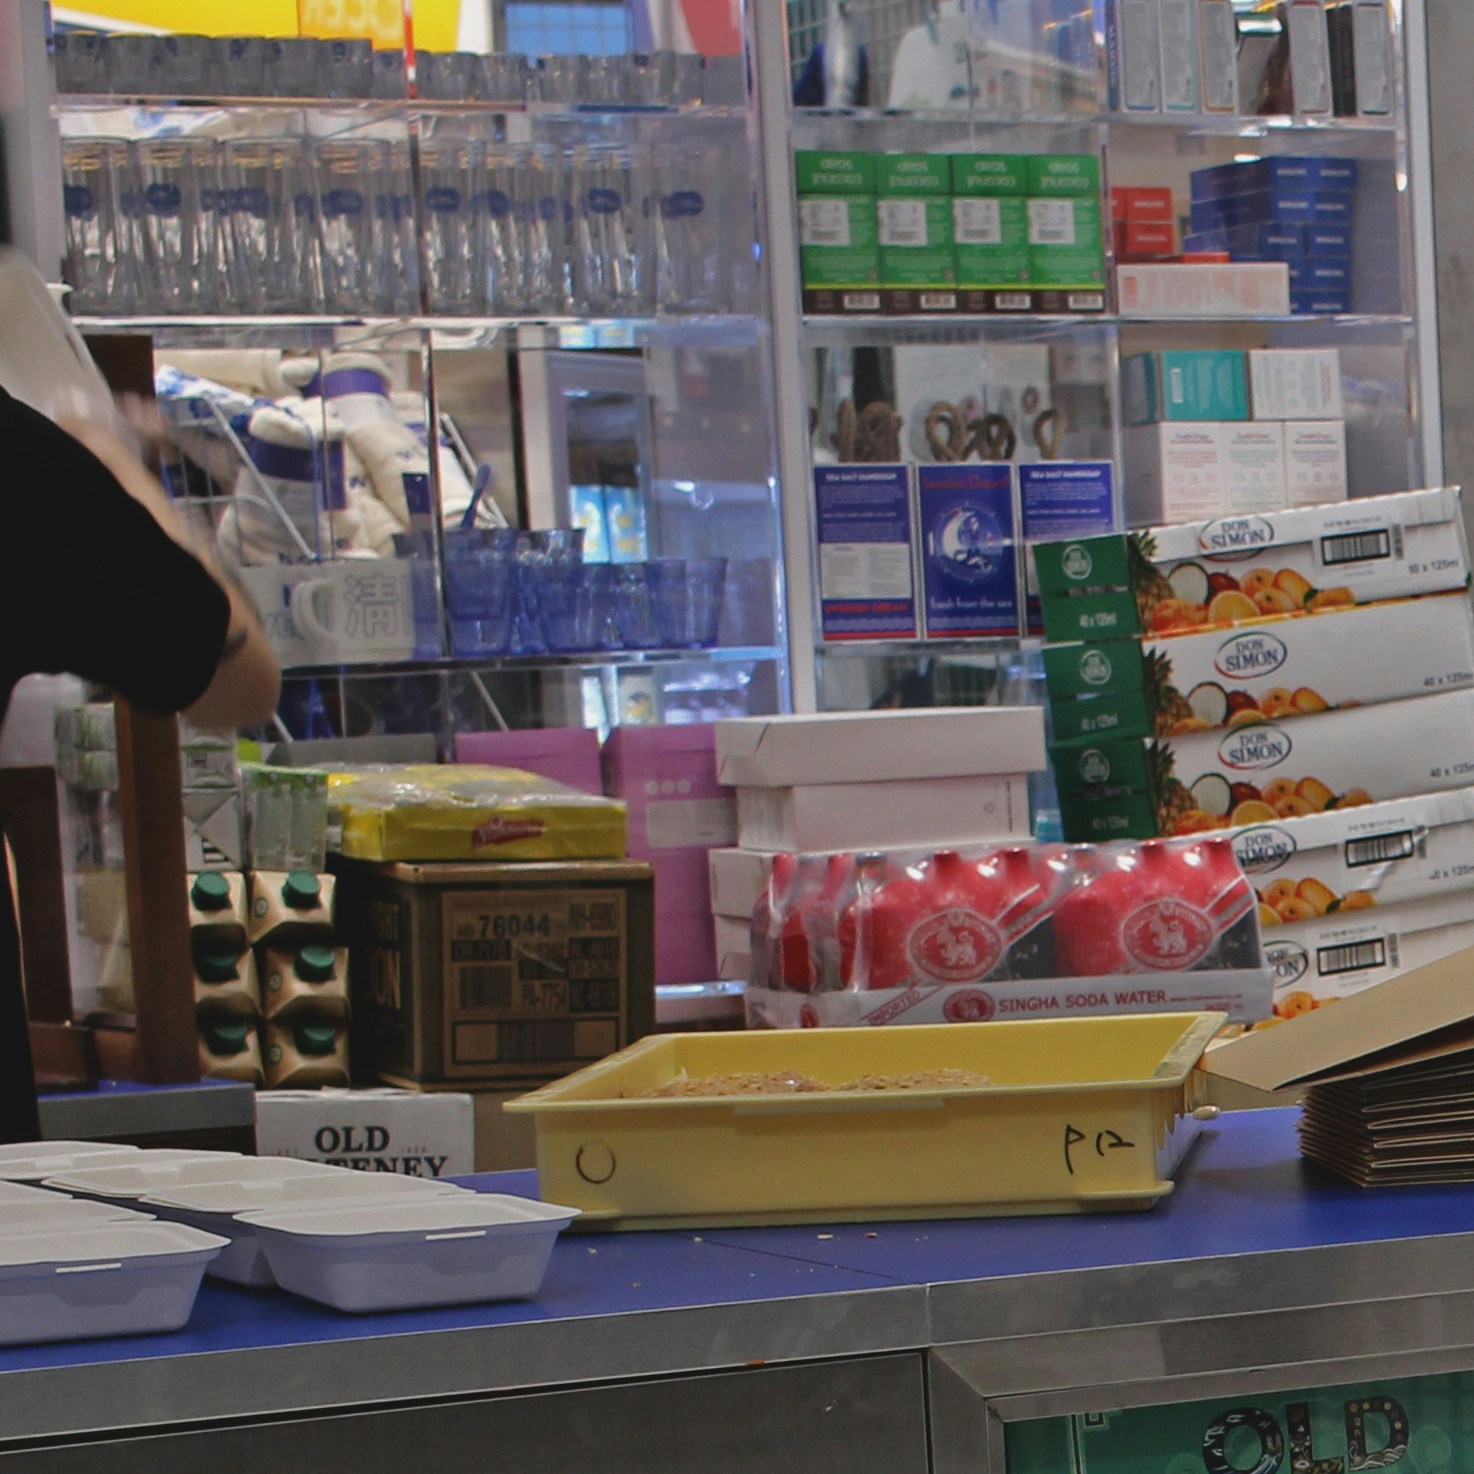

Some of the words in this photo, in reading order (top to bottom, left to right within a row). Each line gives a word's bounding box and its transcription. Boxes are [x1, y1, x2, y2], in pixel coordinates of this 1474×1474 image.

[1220, 519, 1250, 533] DON
[1211, 528, 1266, 549] SIMON
[1235, 639, 1263, 652] DON
[1225, 649, 1278, 672] SIMON
[1240, 732, 1268, 747] DON
[1230, 742, 1284, 765] SIMON
[1244, 833, 1273, 846] DON
[479, 913, 550, 938] 76044
[999, 996, 1060, 1013] SINGHA
[1065, 993, 1110, 1008] SODA
[1114, 990, 1166, 1006] WATER
[314, 1125, 390, 1153] OLD
